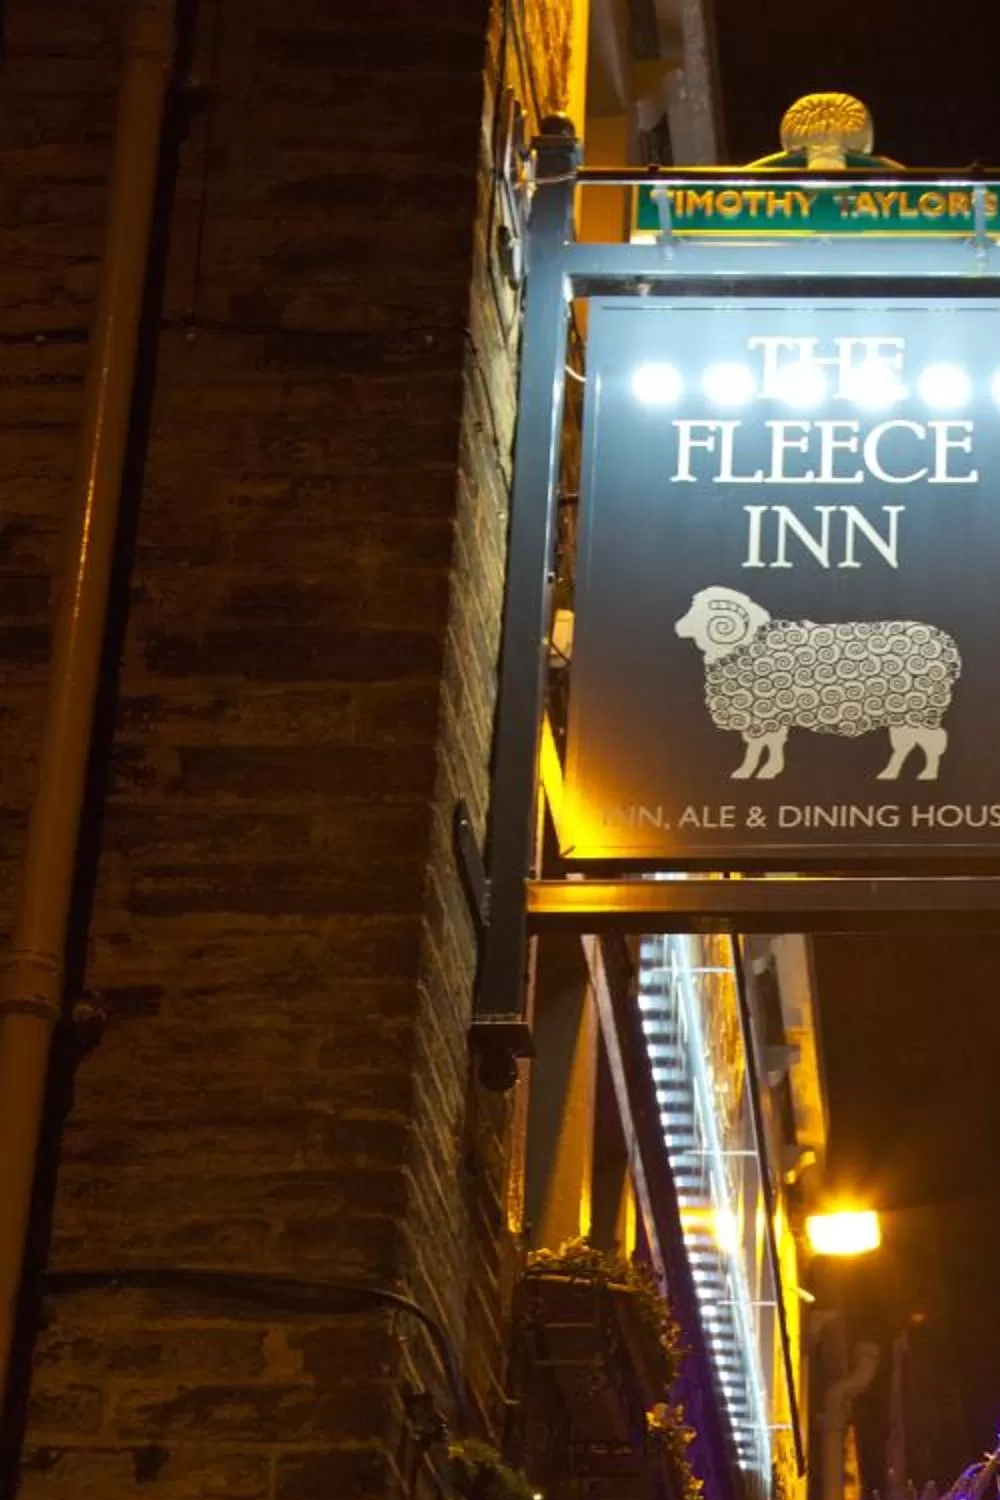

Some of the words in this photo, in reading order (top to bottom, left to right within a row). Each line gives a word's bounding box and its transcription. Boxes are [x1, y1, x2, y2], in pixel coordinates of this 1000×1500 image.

[748, 336, 908, 400] THE
[670, 420, 978, 483] FLEECE
[741, 505, 905, 569] INN
[678, 805, 736, 828] ALE
[746, 805, 768, 829] &
[778, 805, 899, 829] DINING
